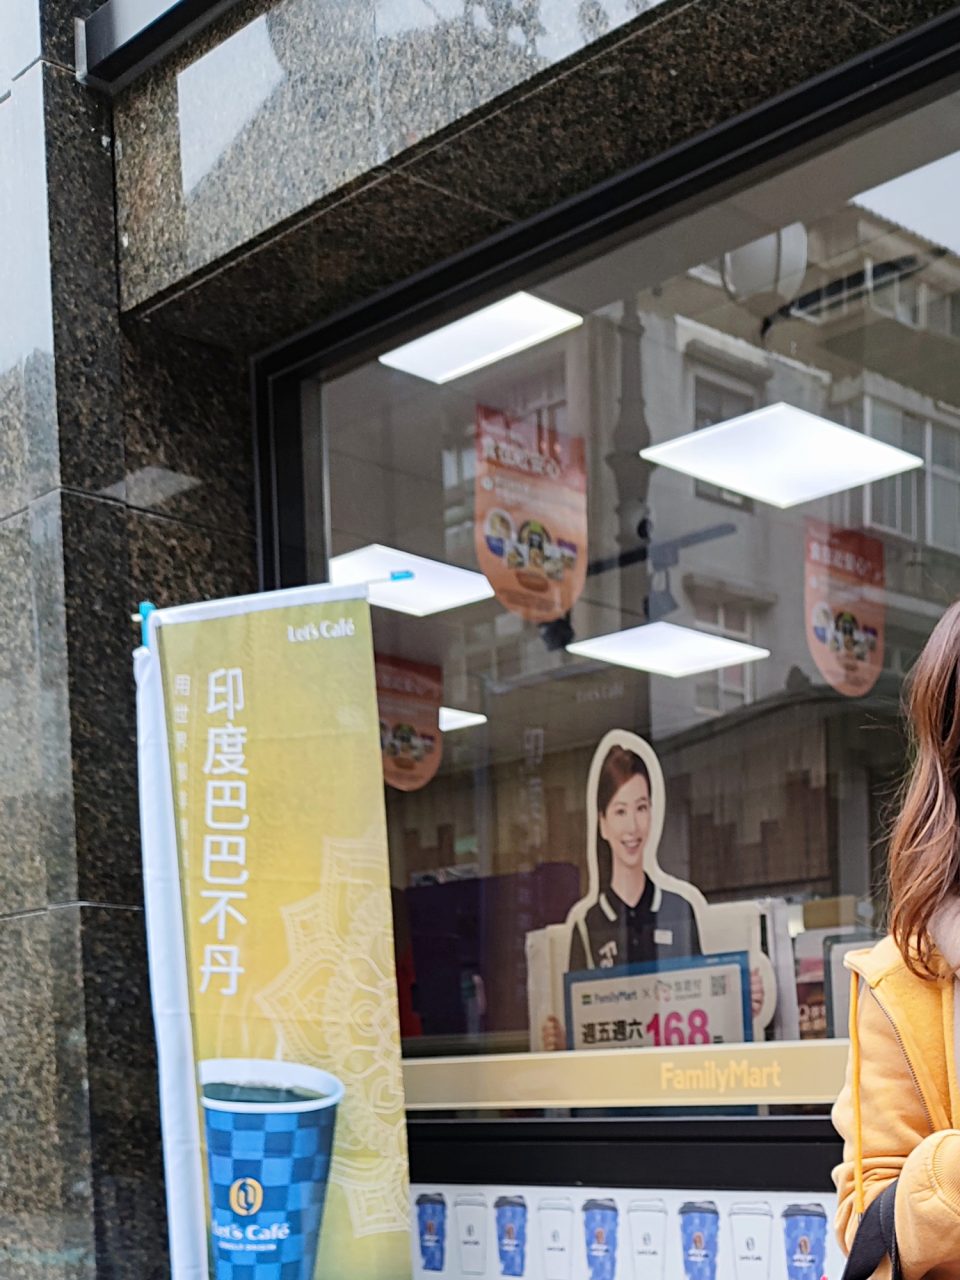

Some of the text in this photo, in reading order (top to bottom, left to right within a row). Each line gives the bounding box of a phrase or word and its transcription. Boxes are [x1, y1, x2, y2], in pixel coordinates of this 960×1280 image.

[199, 667, 250, 996] 印度巴巴不丹
[582, 1018, 644, 1044] 週五週六
[661, 1059, 782, 1093] FamilyMart
